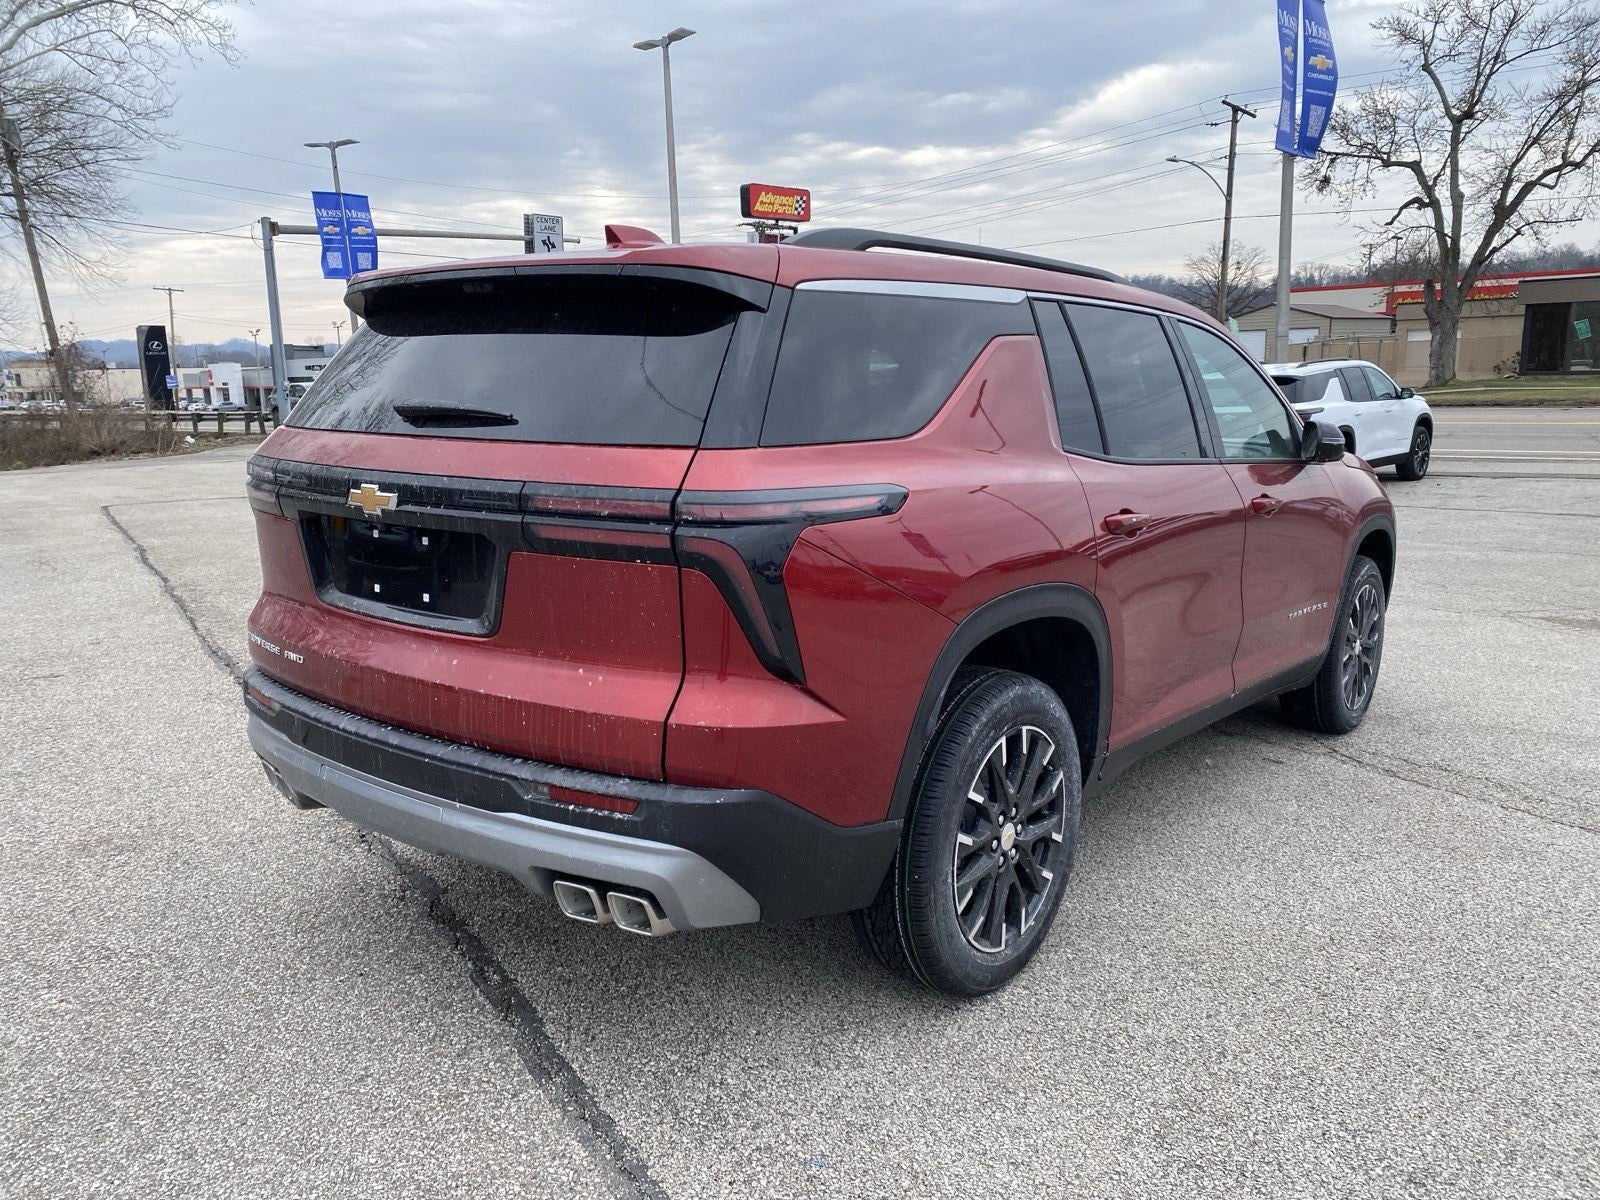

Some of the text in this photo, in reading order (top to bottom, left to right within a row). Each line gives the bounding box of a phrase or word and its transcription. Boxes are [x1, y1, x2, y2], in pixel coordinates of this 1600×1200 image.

[759, 191, 793, 205] Advance
[316, 208, 342, 218] MOSES
[753, 200, 793, 214] Auto Parts
[346, 209, 371, 220] MOSES
[535, 216, 560, 225] CENTER
[1288, 602, 1328, 620] TRAVERSE
[284, 650, 304, 664] AWD
